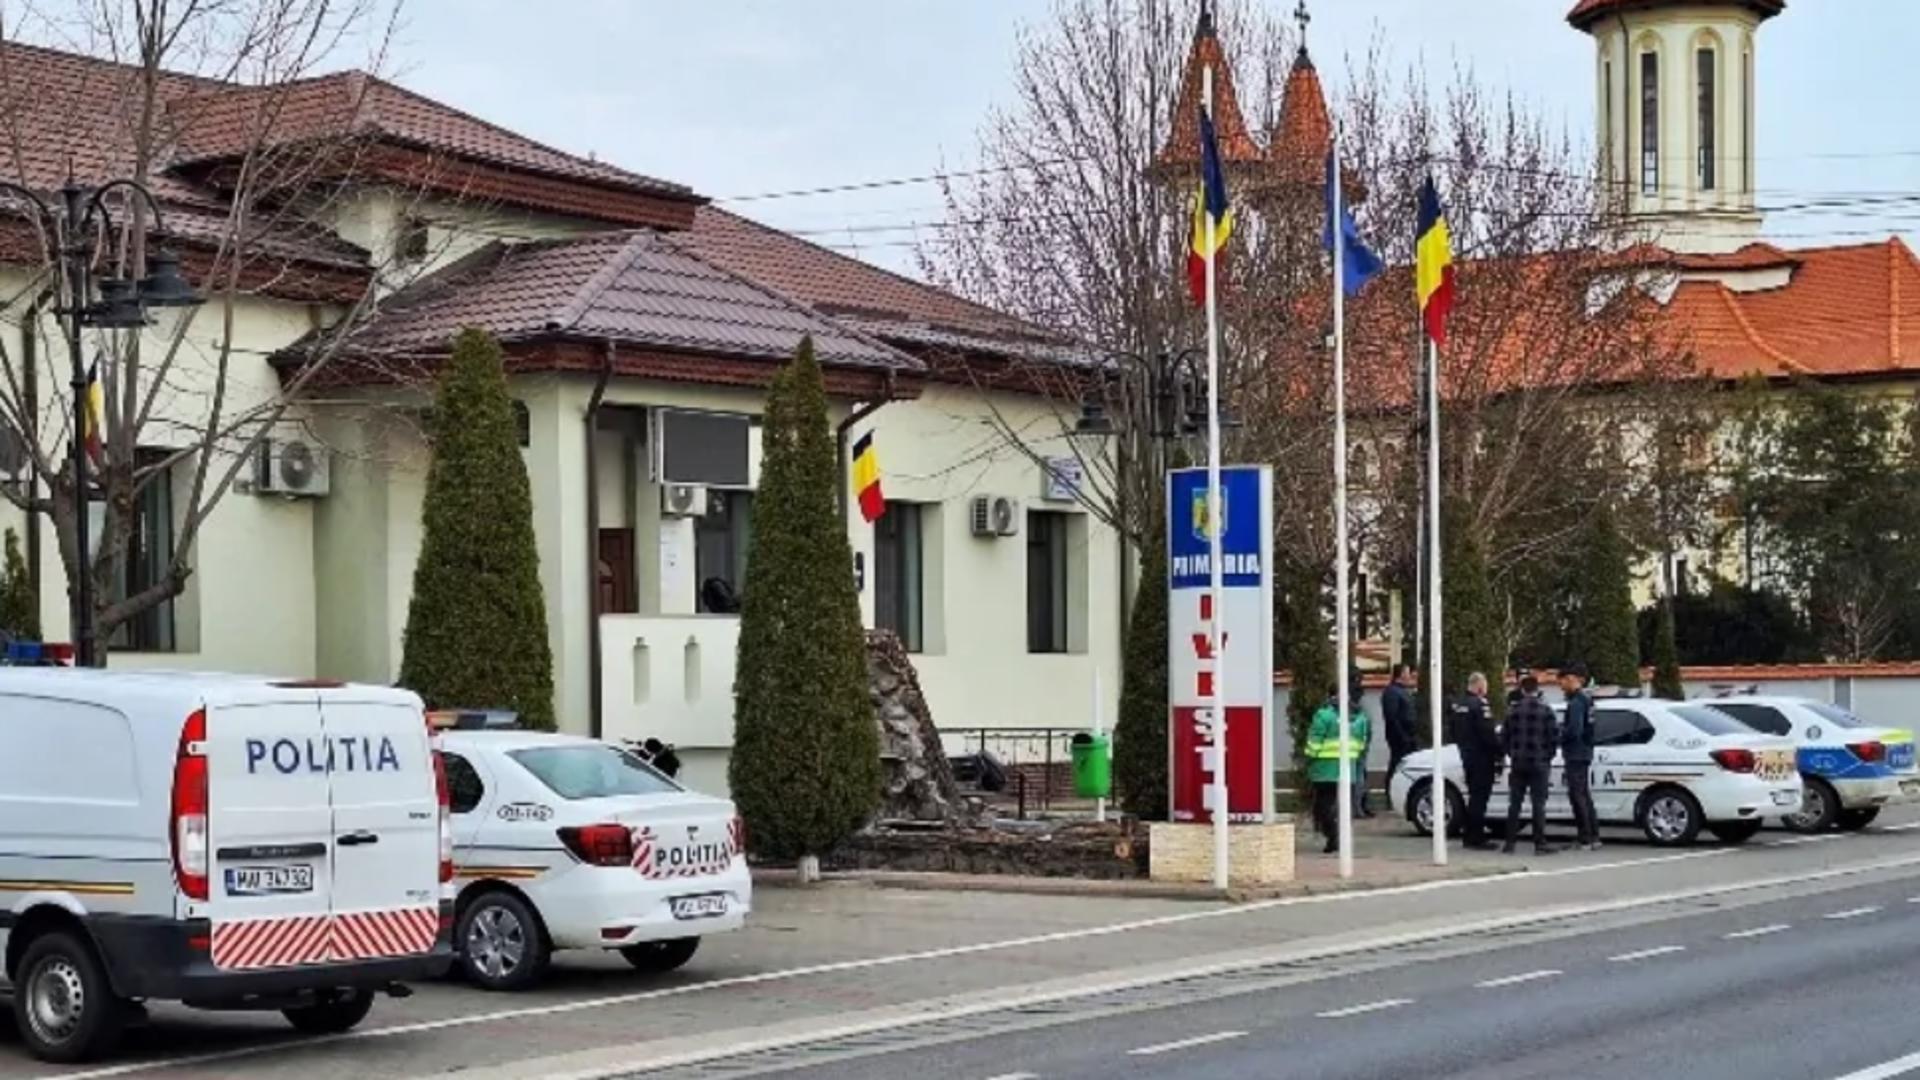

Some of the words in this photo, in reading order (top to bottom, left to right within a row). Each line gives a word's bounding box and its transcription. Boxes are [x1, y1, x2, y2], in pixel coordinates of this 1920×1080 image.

[1173, 554, 1260, 576] PRIMRIA
[246, 736, 400, 774] POLITIA
[655, 842, 731, 867] POLITIA
